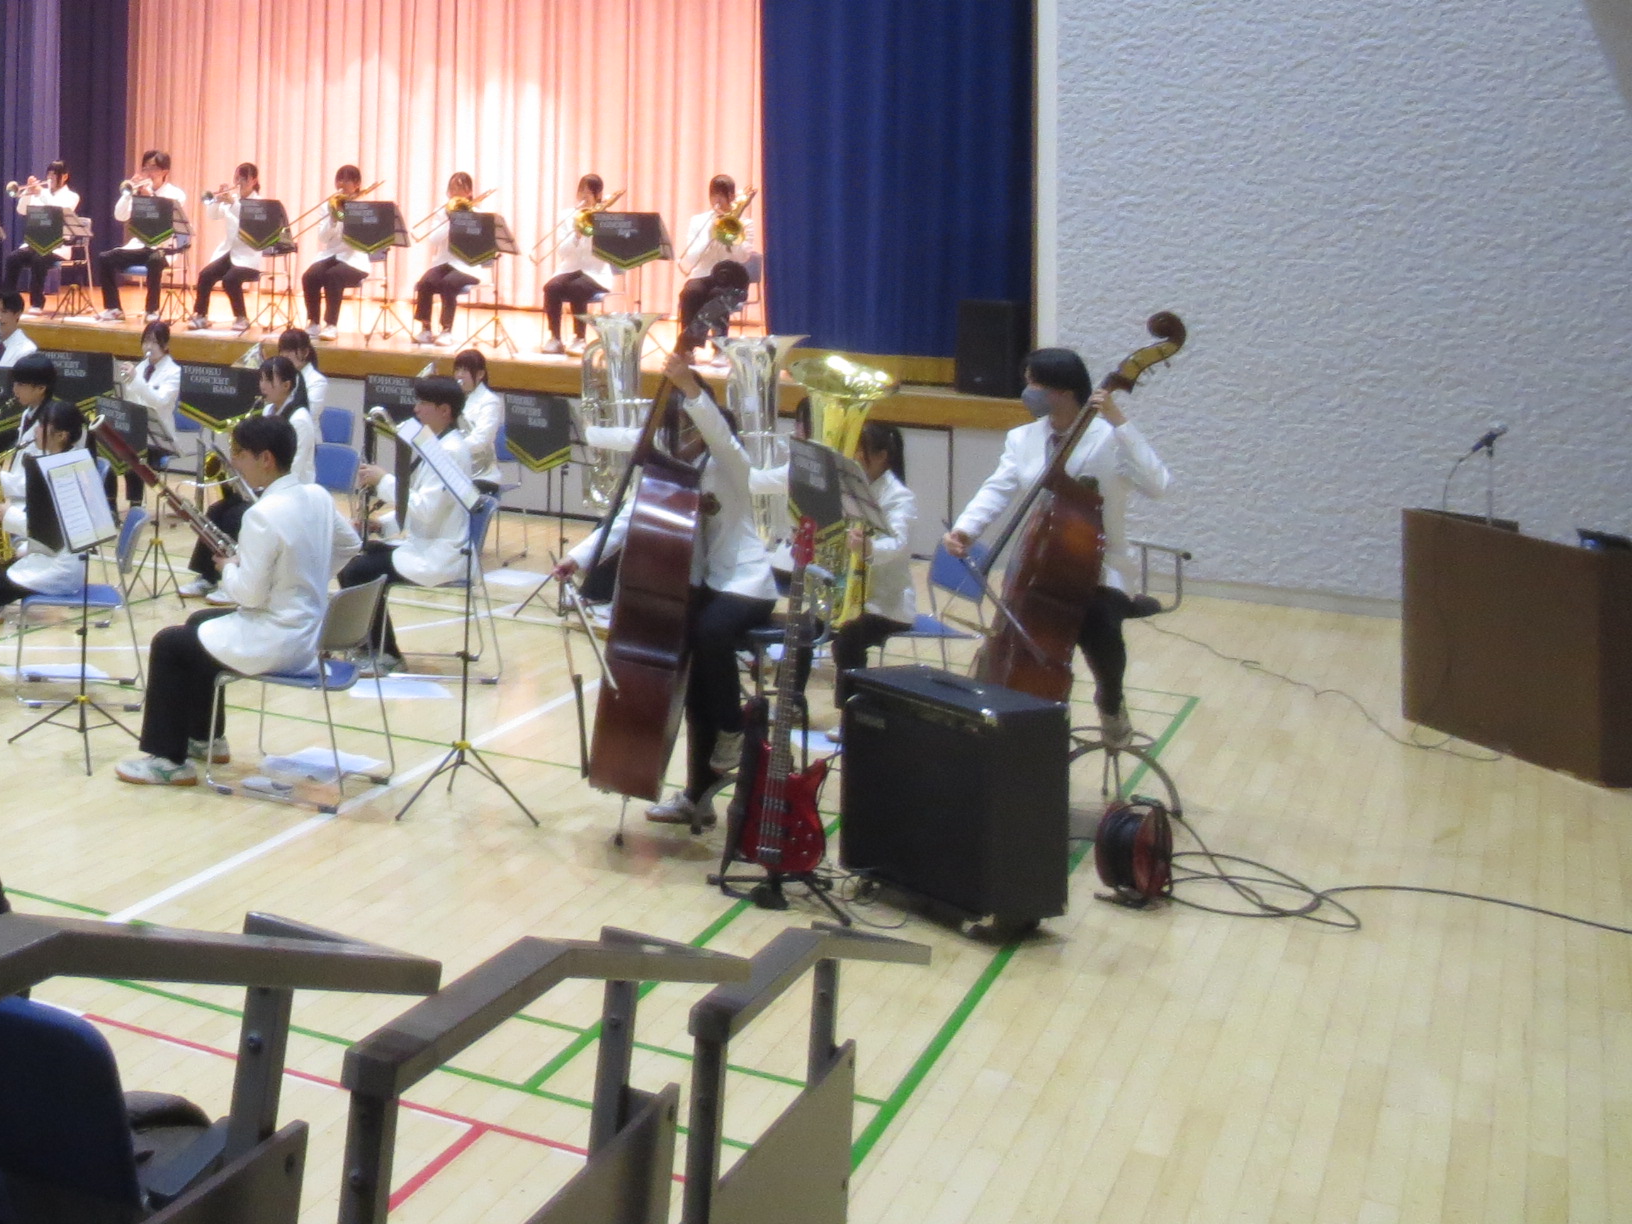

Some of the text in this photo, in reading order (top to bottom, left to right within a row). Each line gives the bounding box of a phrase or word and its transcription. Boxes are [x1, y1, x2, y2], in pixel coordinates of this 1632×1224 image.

[64, 369, 86, 377] BAND
[183, 365, 221, 376] TOHOKU
[190, 375, 229, 385] CONCERT
[368, 376, 409, 387] TOHOKU
[213, 385, 236, 394] BAND
